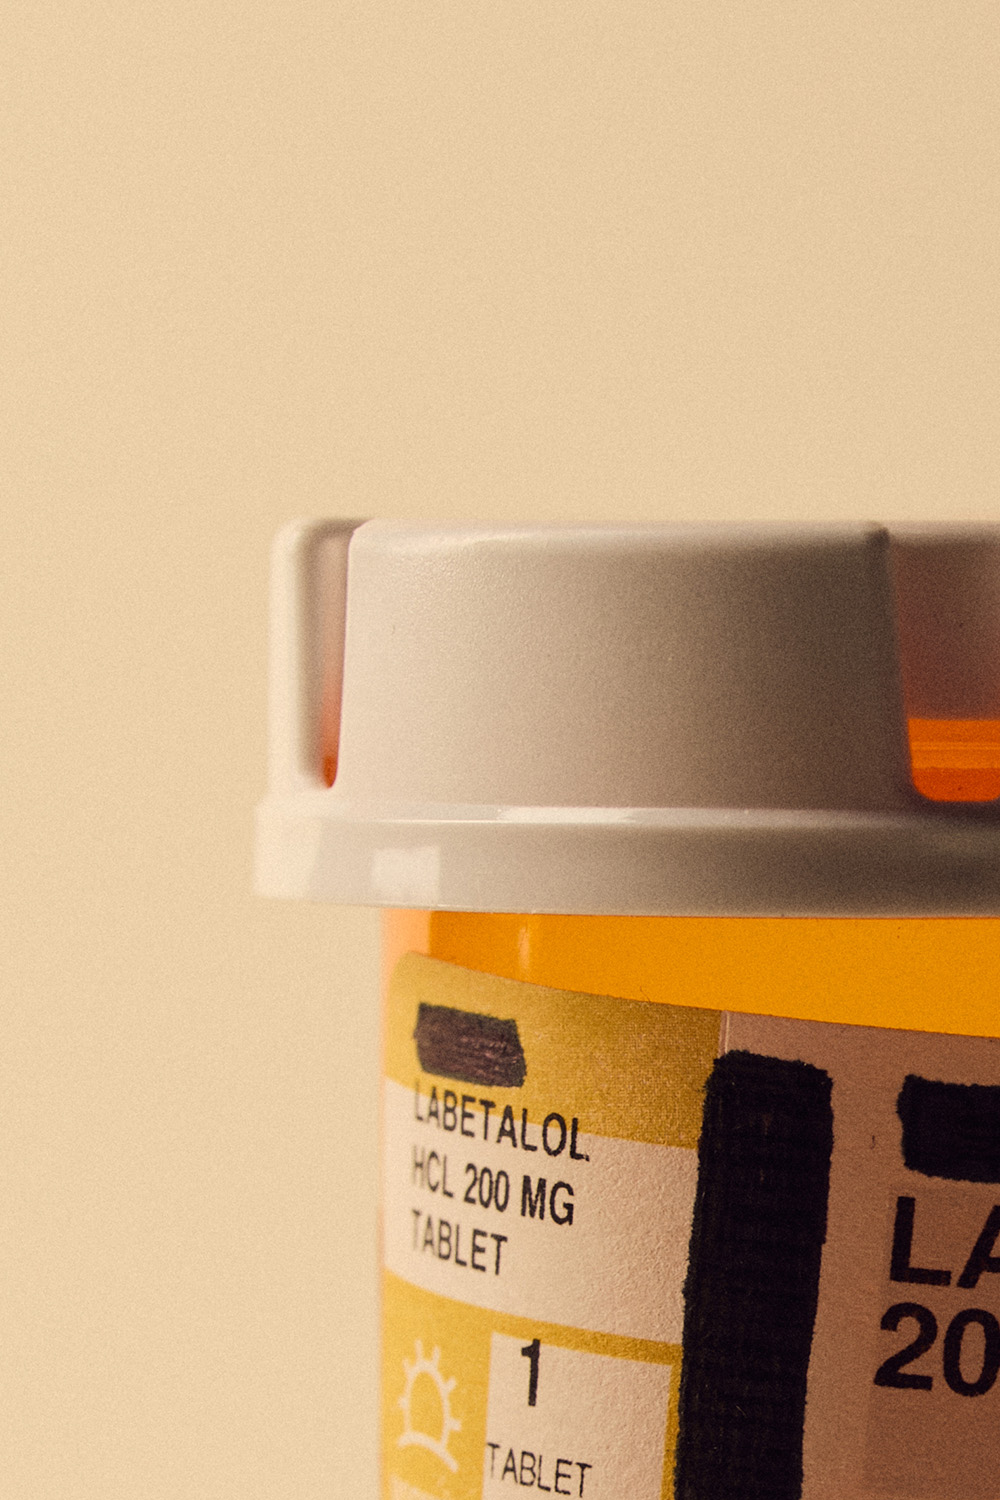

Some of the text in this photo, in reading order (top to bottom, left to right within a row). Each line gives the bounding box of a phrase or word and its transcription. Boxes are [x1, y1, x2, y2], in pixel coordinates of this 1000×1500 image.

[414, 1079, 590, 1162] LABETALOL
[412, 1144, 575, 1227] HCL 200 MG
[412, 1208, 508, 1276] TABLET
[520, 1338, 541, 1407] 1
[486, 1441, 593, 1499] TABLET
